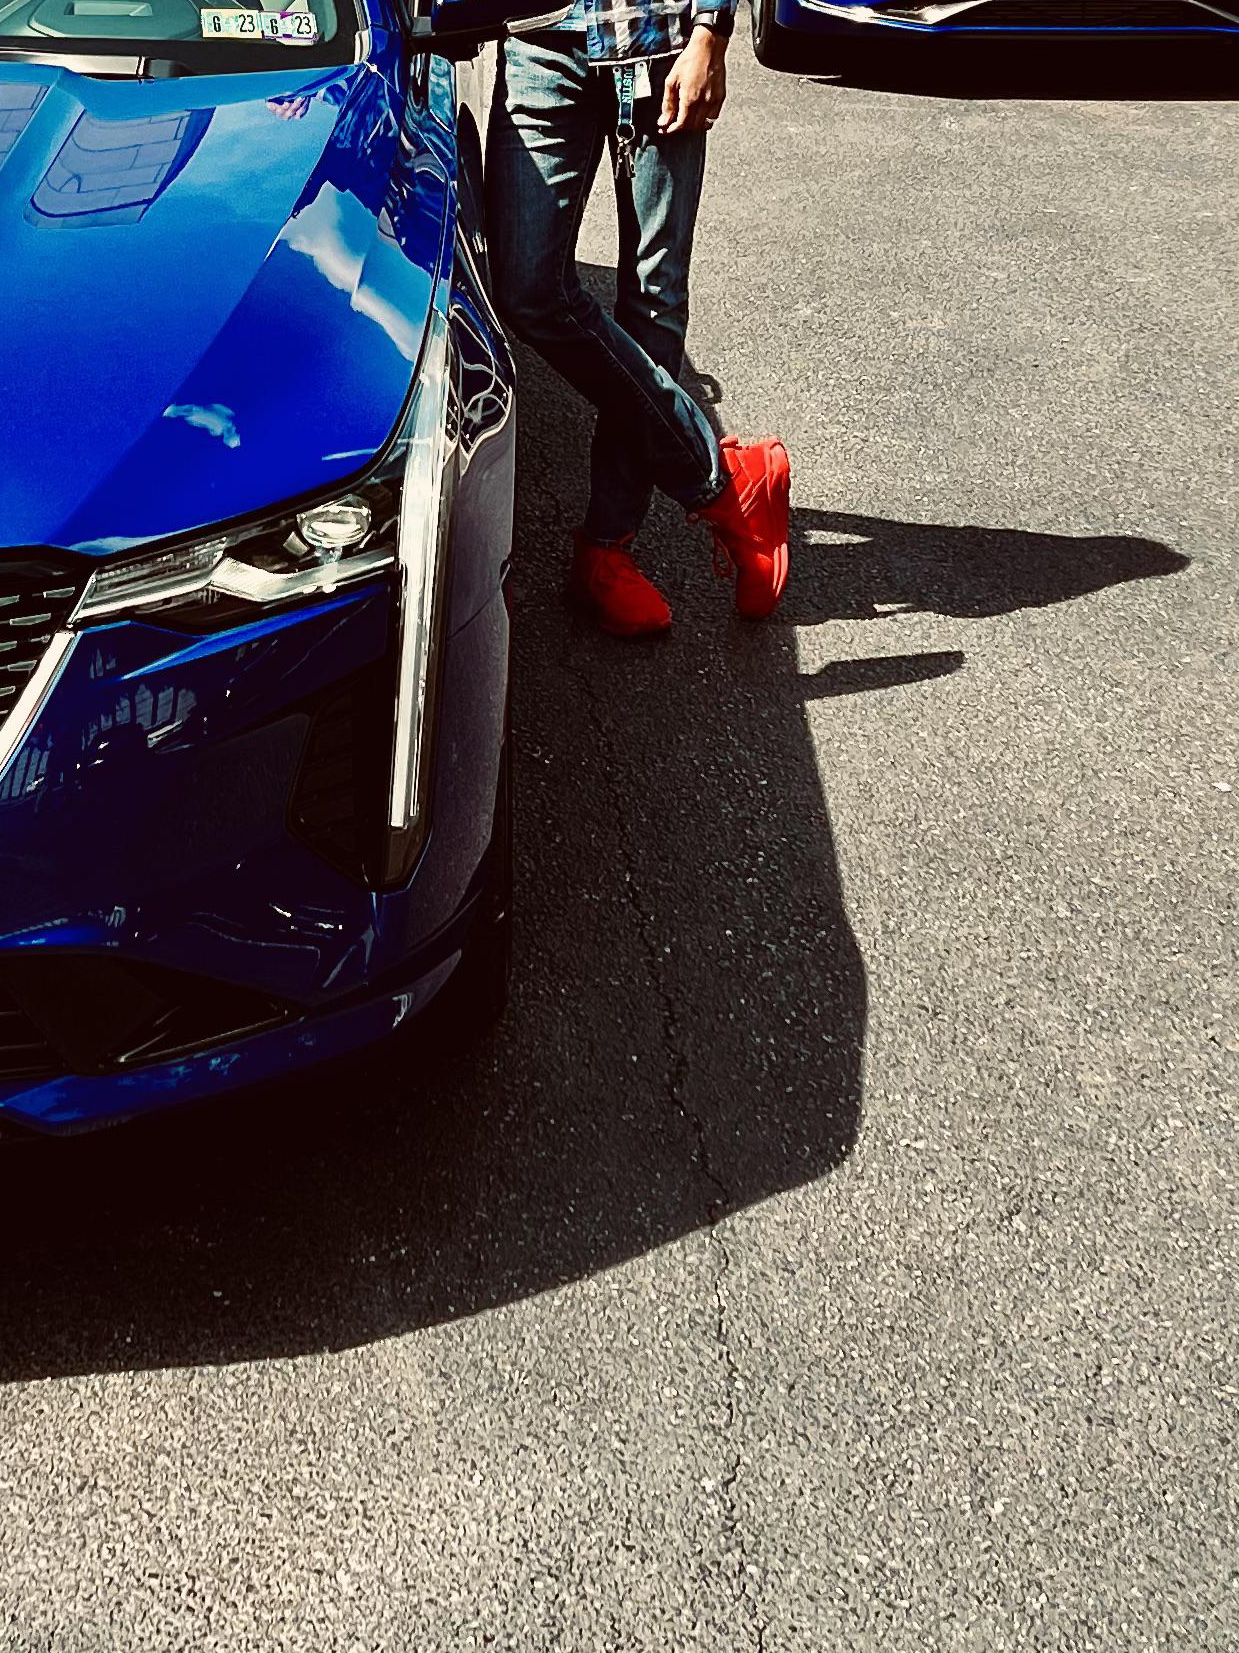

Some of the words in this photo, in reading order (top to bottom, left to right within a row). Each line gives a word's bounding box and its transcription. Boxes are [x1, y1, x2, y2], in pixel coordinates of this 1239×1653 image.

[238, 13, 256, 33] 23
[269, 18, 279, 35] 6
[295, 15, 312, 35] 23
